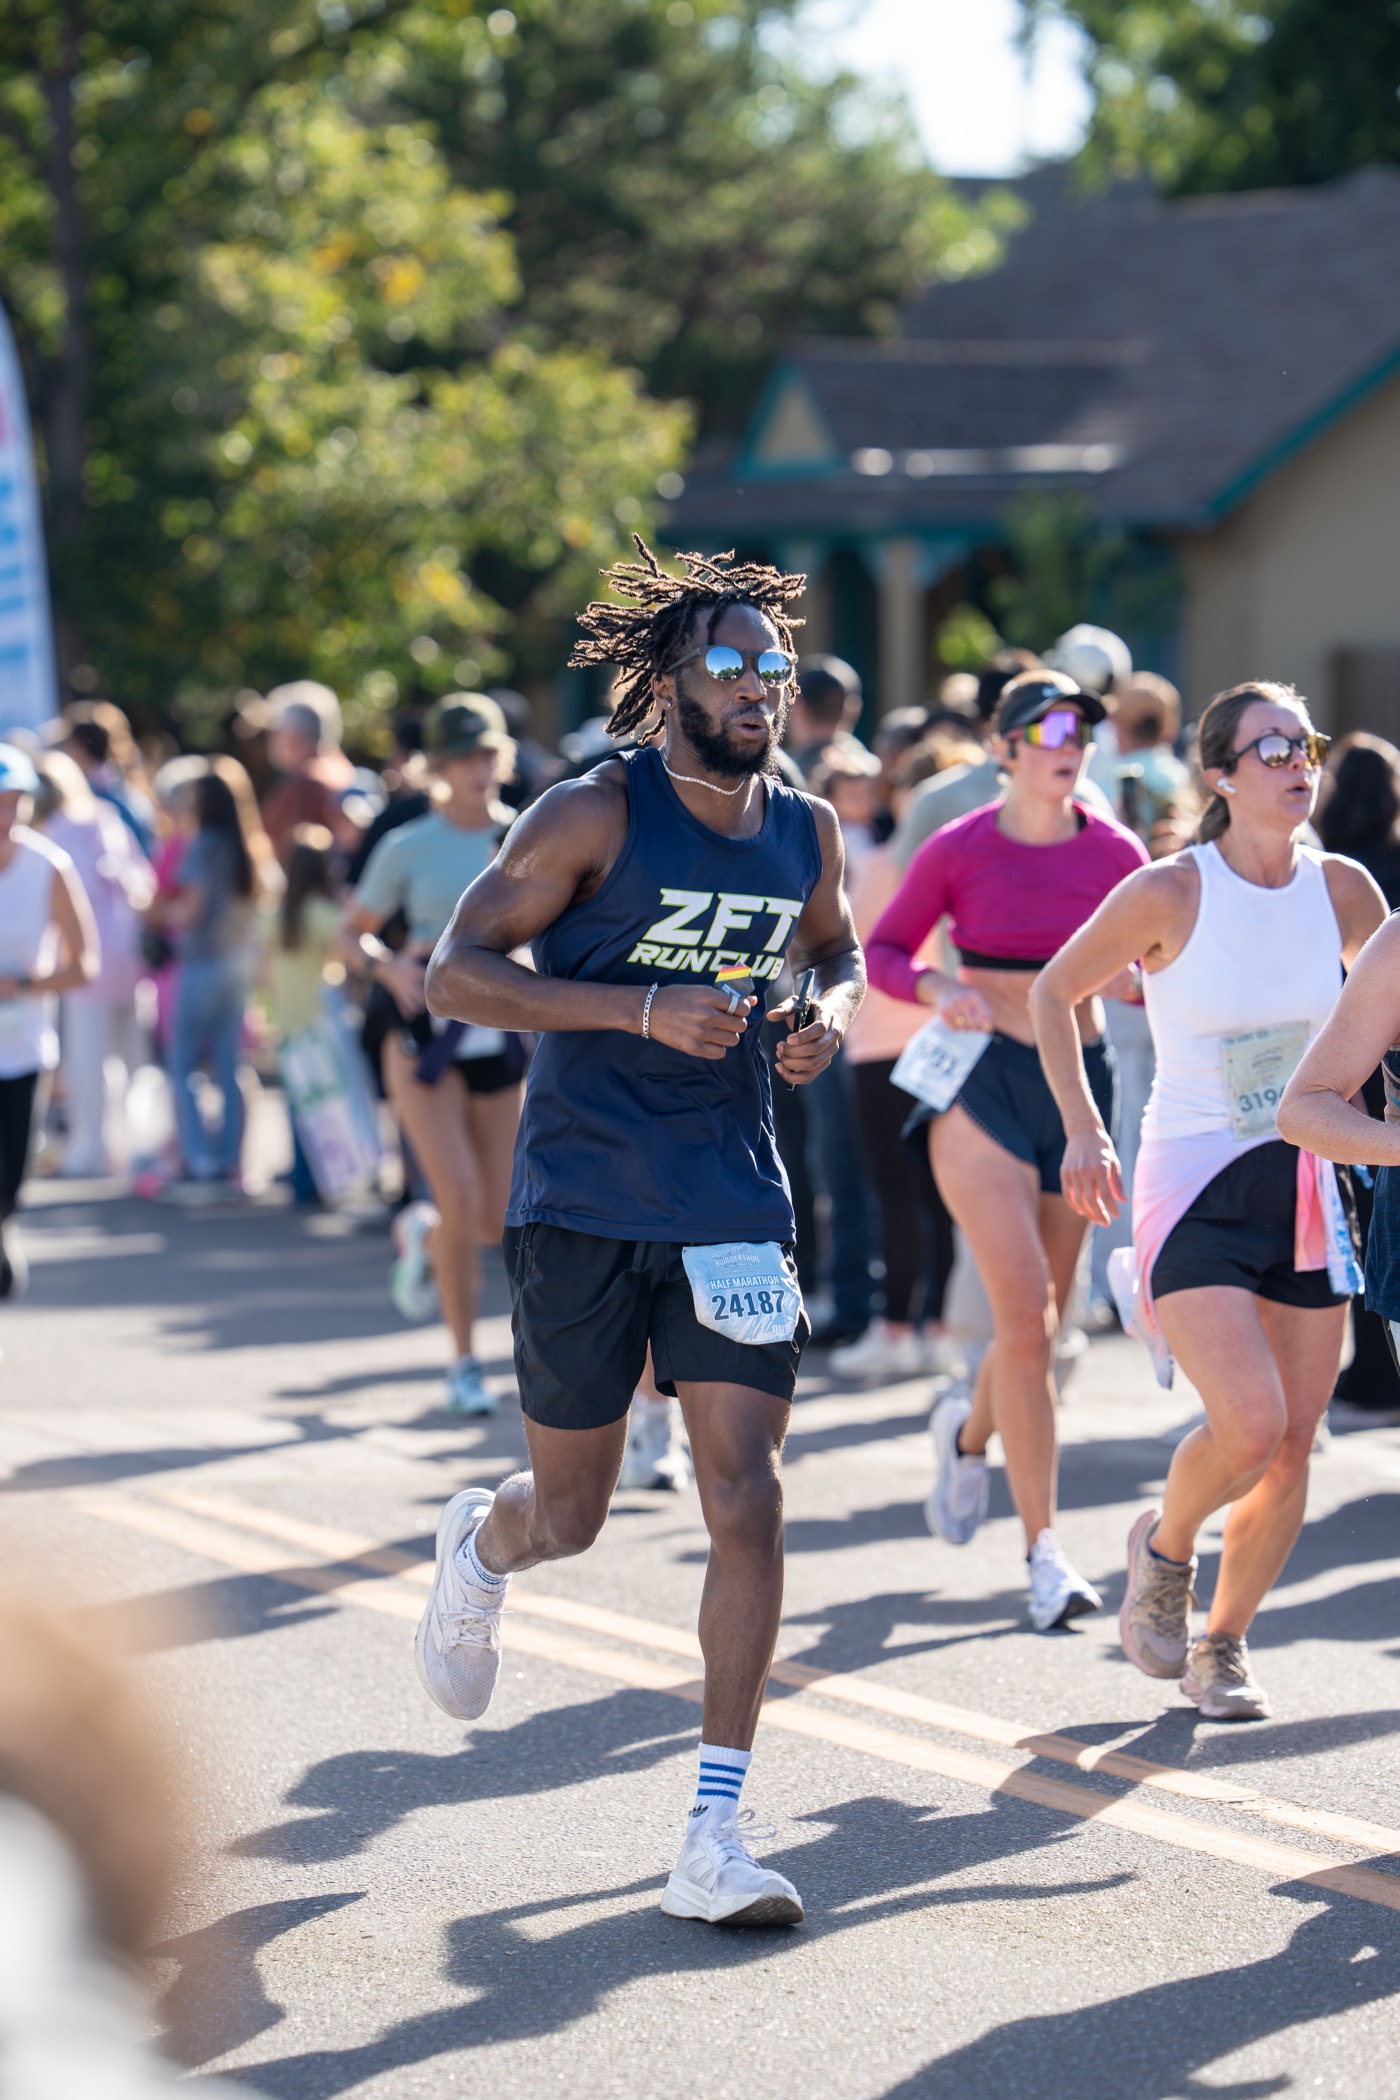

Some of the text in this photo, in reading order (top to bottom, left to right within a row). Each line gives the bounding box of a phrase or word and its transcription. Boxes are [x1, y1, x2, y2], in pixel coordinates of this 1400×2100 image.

[642, 887, 804, 953] ZFT
[627, 942, 713, 973] RUN
[1238, 1084, 1286, 1113] 319
[710, 1275, 780, 1290] HALF MARATHON
[711, 1289, 785, 1321] 24187
